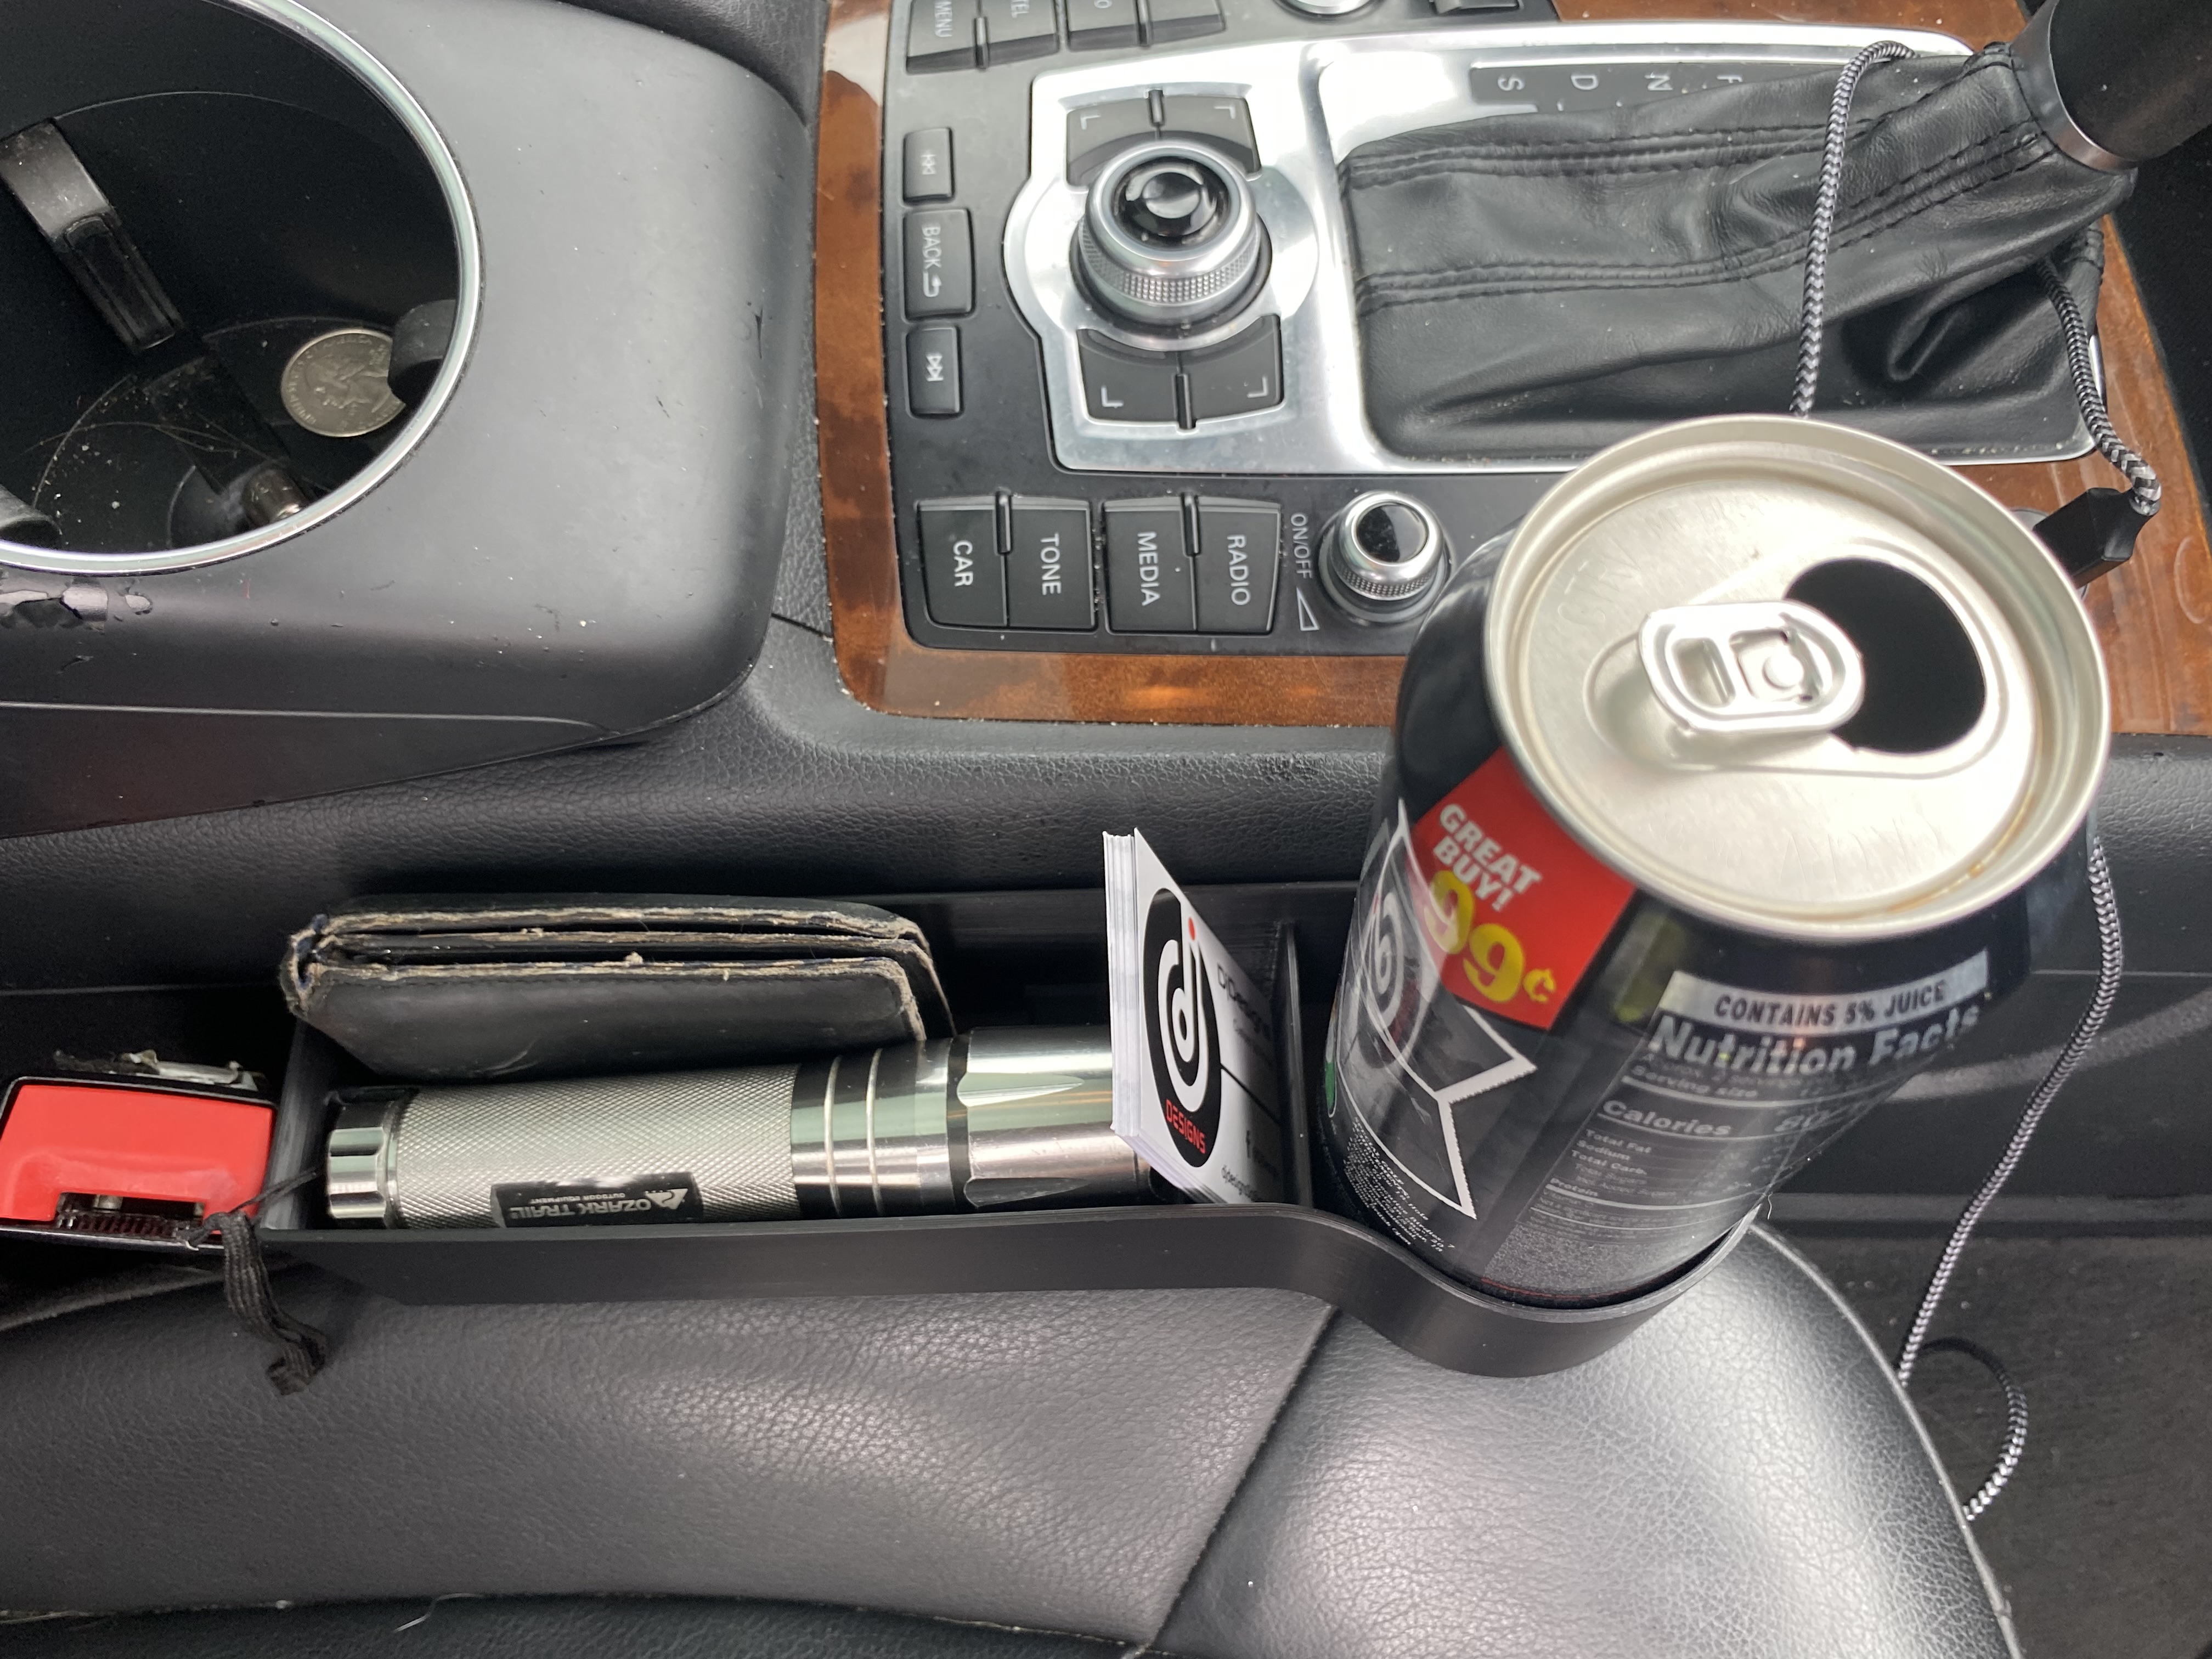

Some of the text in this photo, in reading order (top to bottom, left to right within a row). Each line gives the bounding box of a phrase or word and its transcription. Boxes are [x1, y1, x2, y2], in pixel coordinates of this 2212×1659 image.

[934, 0, 953, 37] MENU
[1497, 75, 1525, 91] S
[1570, 73, 1599, 91] D
[1644, 70, 1673, 91] N
[923, 225, 941, 269] BACK
[952, 540, 973, 587] CAR
[1040, 533, 1062, 595] TONE
[1290, 513, 1313, 579] ON/OFF
[1137, 531, 1160, 606] MEDIA
[1227, 534, 1251, 606] RADIO
[1439, 803, 1543, 895] GREAT
[1432, 836, 1514, 912] BUY!
[1713, 980, 1949, 1026] CONTAINS 5% JUICE
[1647, 1014, 1857, 1075] Nutrition
[1869, 1005, 1981, 1066] Facts
[1165, 1098, 1206, 1154] DESIGNS
[1602, 1099, 1732, 1136] Calories
[1571, 1149, 1608, 1167] Total
[1576, 1139, 1630, 1161] Sodium
[1586, 1128, 1652, 1153] Total Fat
[1372, 1168, 1382, 1180] 60
[1381, 1160, 1404, 1185] GOLF
[1550, 1177, 1599, 1197] Protein
[510, 1198, 652, 1218] OZARK TRAIL
[528, 1196, 580, 1204] EQUIPMENT
[1380, 1172, 1393, 1187] low
[1396, 1191, 1429, 1221] 18-Hole
